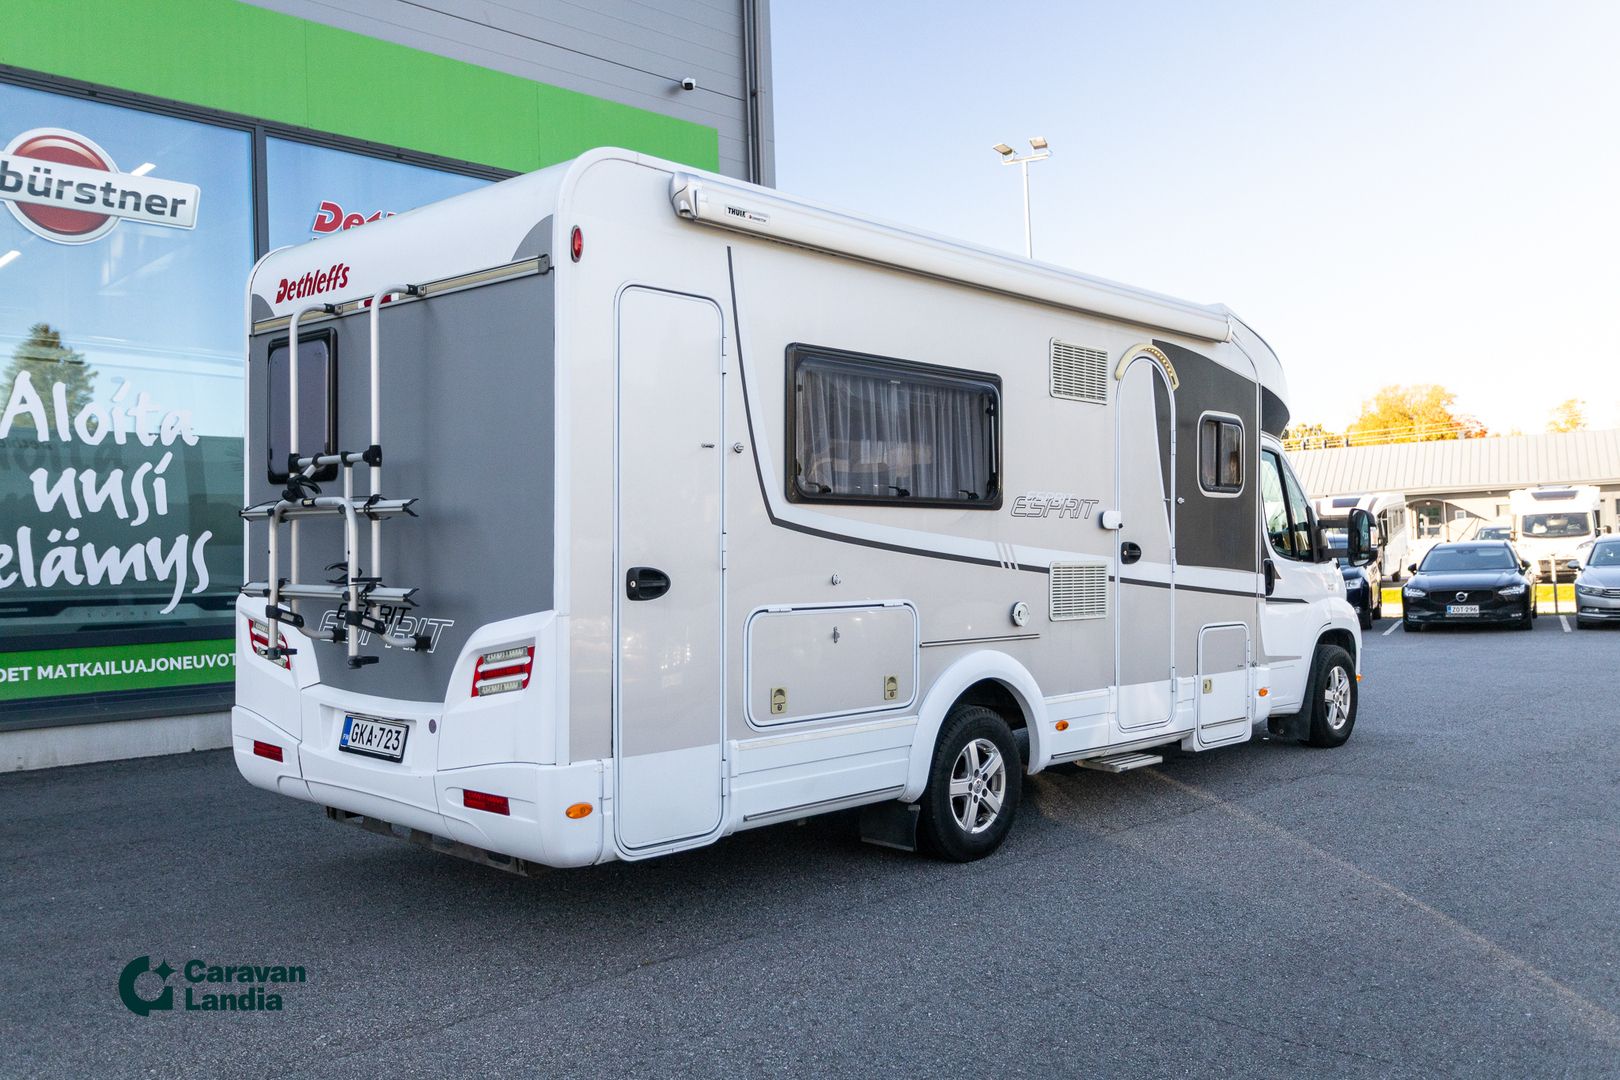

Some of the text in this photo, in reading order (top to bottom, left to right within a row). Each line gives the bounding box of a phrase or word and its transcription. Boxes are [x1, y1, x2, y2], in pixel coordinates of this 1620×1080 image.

[0, 159, 187, 218] bürstner
[275, 262, 350, 305] Dethleffs
[0, 369, 200, 447] Aloita
[29, 451, 173, 527] uusi
[1010, 496, 1099, 519] ESPRIT
[351, 722, 402, 751] GKA-723
